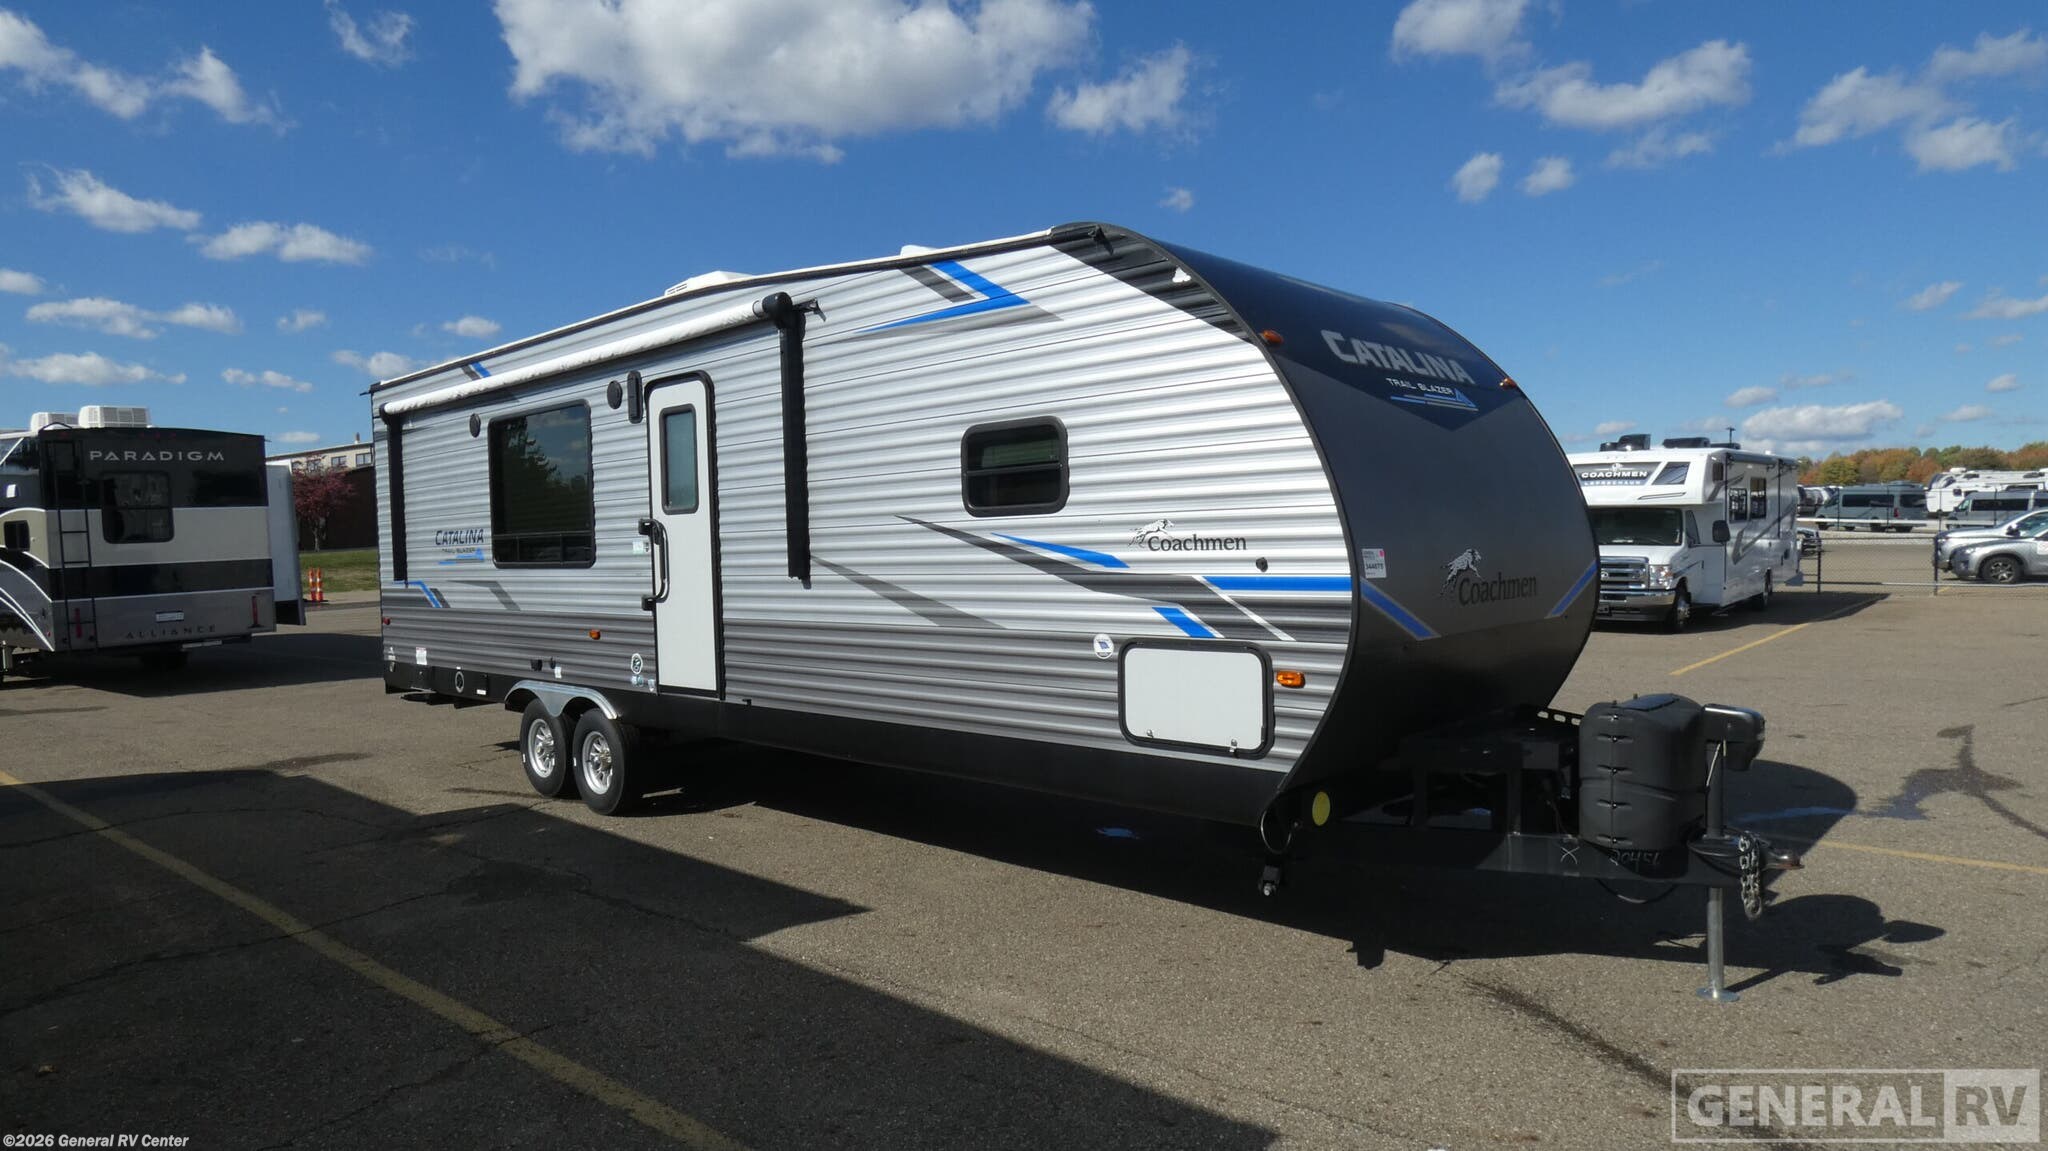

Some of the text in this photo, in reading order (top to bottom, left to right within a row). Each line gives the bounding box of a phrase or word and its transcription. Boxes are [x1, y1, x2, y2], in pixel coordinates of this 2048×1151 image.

[1320, 329, 1476, 385] CATALINA
[1385, 377, 1455, 395] TRAIL BLAZER
[89, 450, 225, 461] PARADIGM
[435, 529, 484, 546] CATALINA
[1147, 534, 1247, 551] Coachmen
[1458, 572, 1537, 606] Coachmen
[126, 624, 216, 639] ALLIANCE
